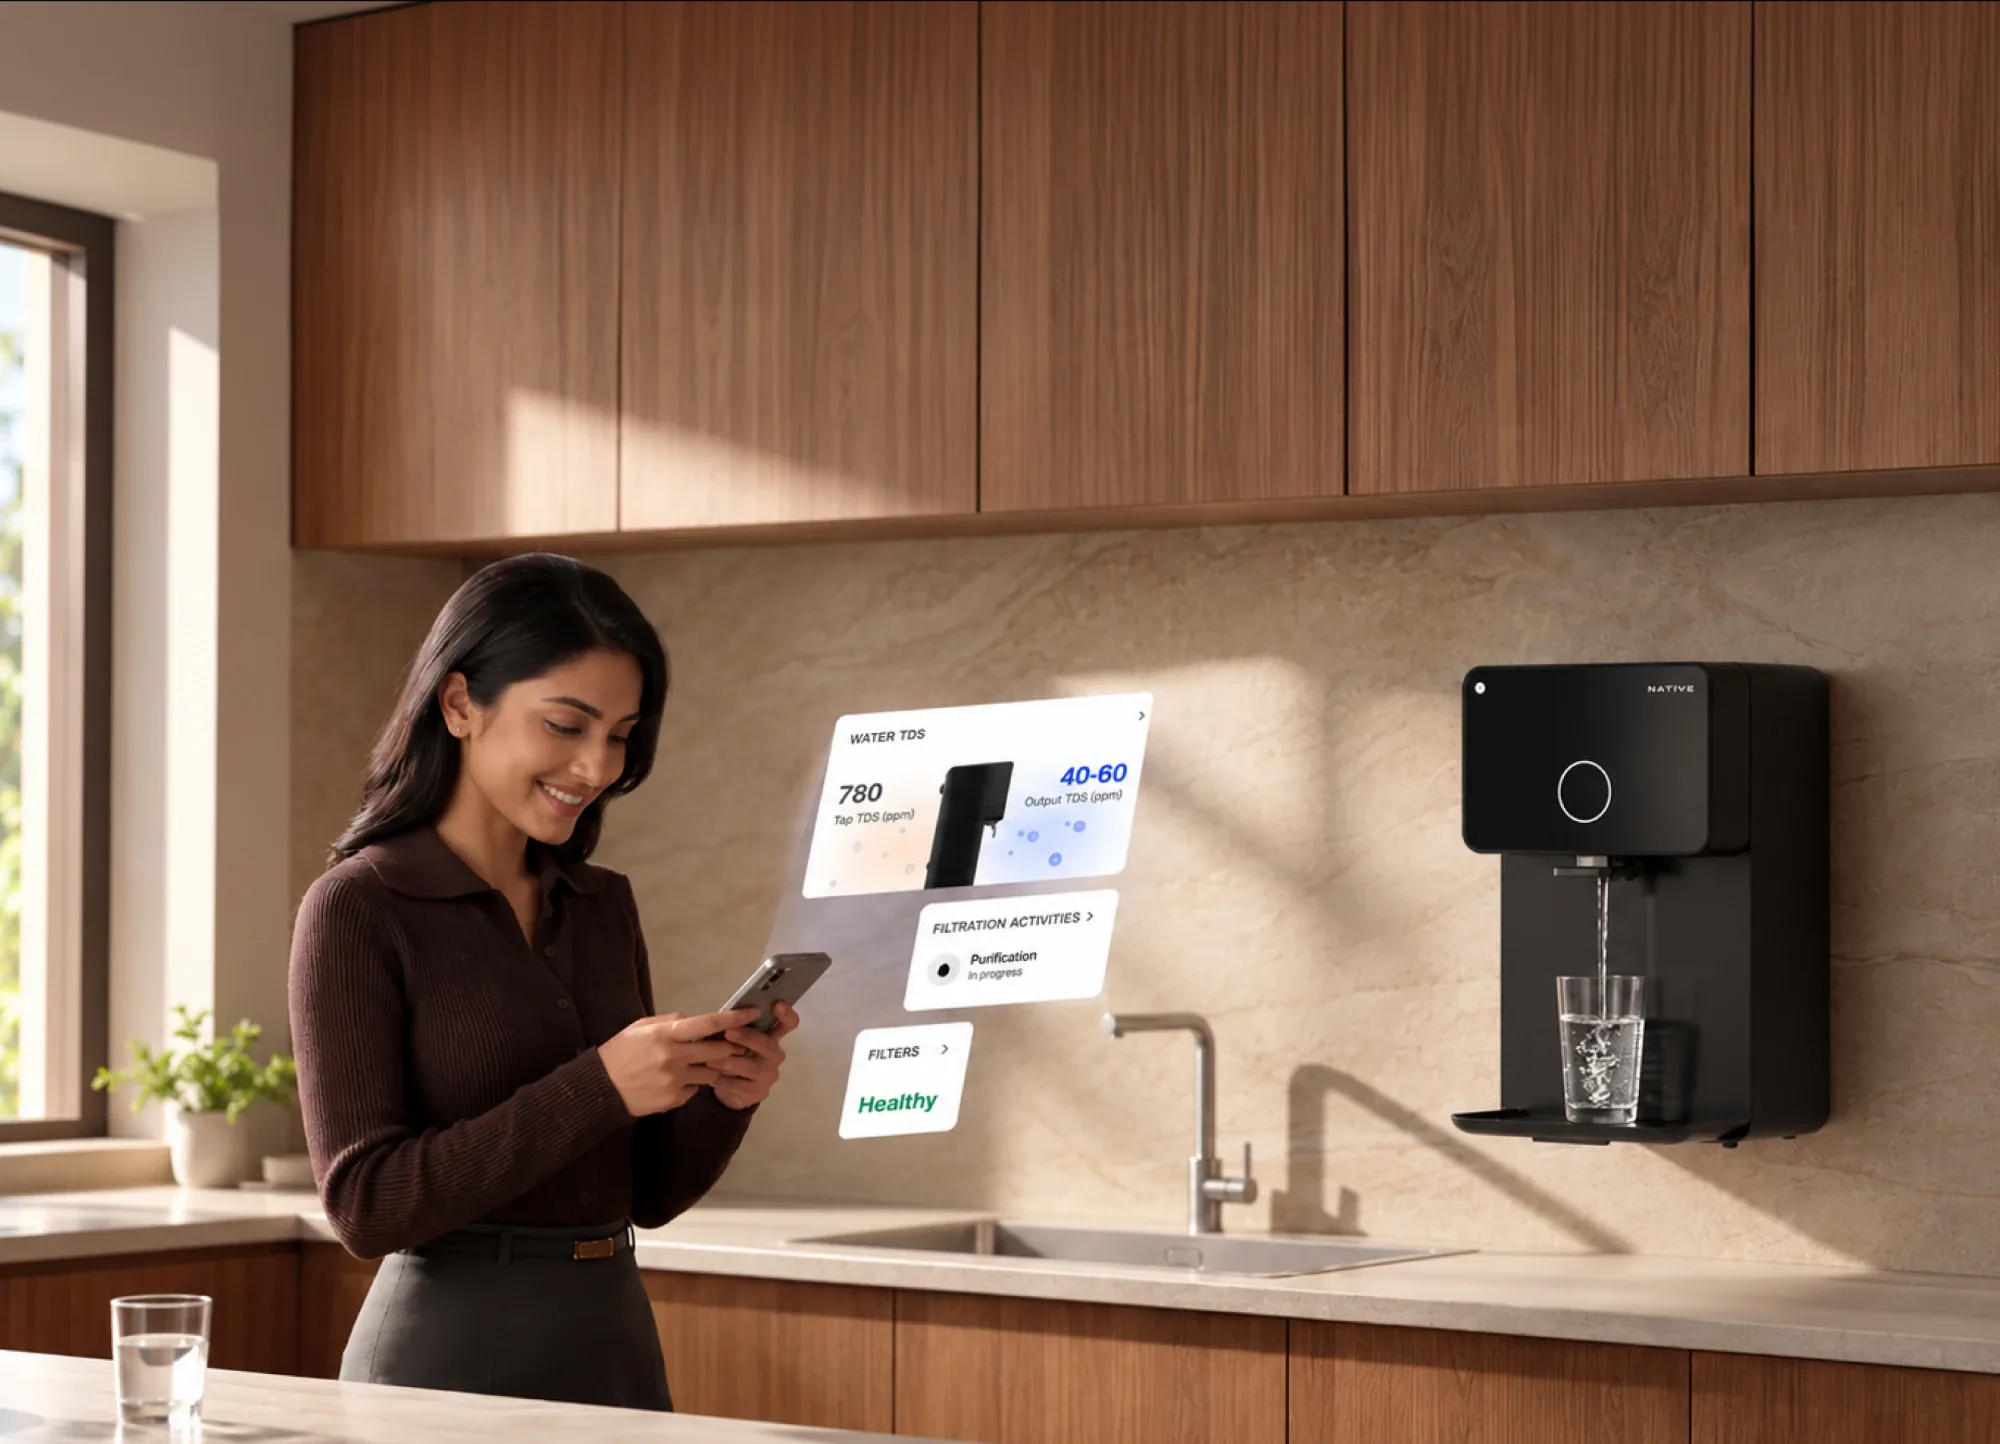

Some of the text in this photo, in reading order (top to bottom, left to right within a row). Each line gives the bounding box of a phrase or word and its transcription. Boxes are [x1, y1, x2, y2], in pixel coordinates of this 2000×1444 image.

[1647, 685, 1694, 693] NATIVE
[850, 728, 926, 745] WATER TDS
[1060, 762, 1128, 786] 40-60
[838, 782, 883, 805] 780
[1024, 788, 1123, 808] Output TDS (ppm)
[834, 808, 915, 826] Tap TDS (ppm)
[932, 911, 1081, 934] FILTRATION ACTIVITIES
[970, 950, 1037, 965] Purification
[967, 967, 1023, 981] In progress
[868, 1045, 920, 1060] FILTERS
[858, 1092, 938, 1114] Healthy
